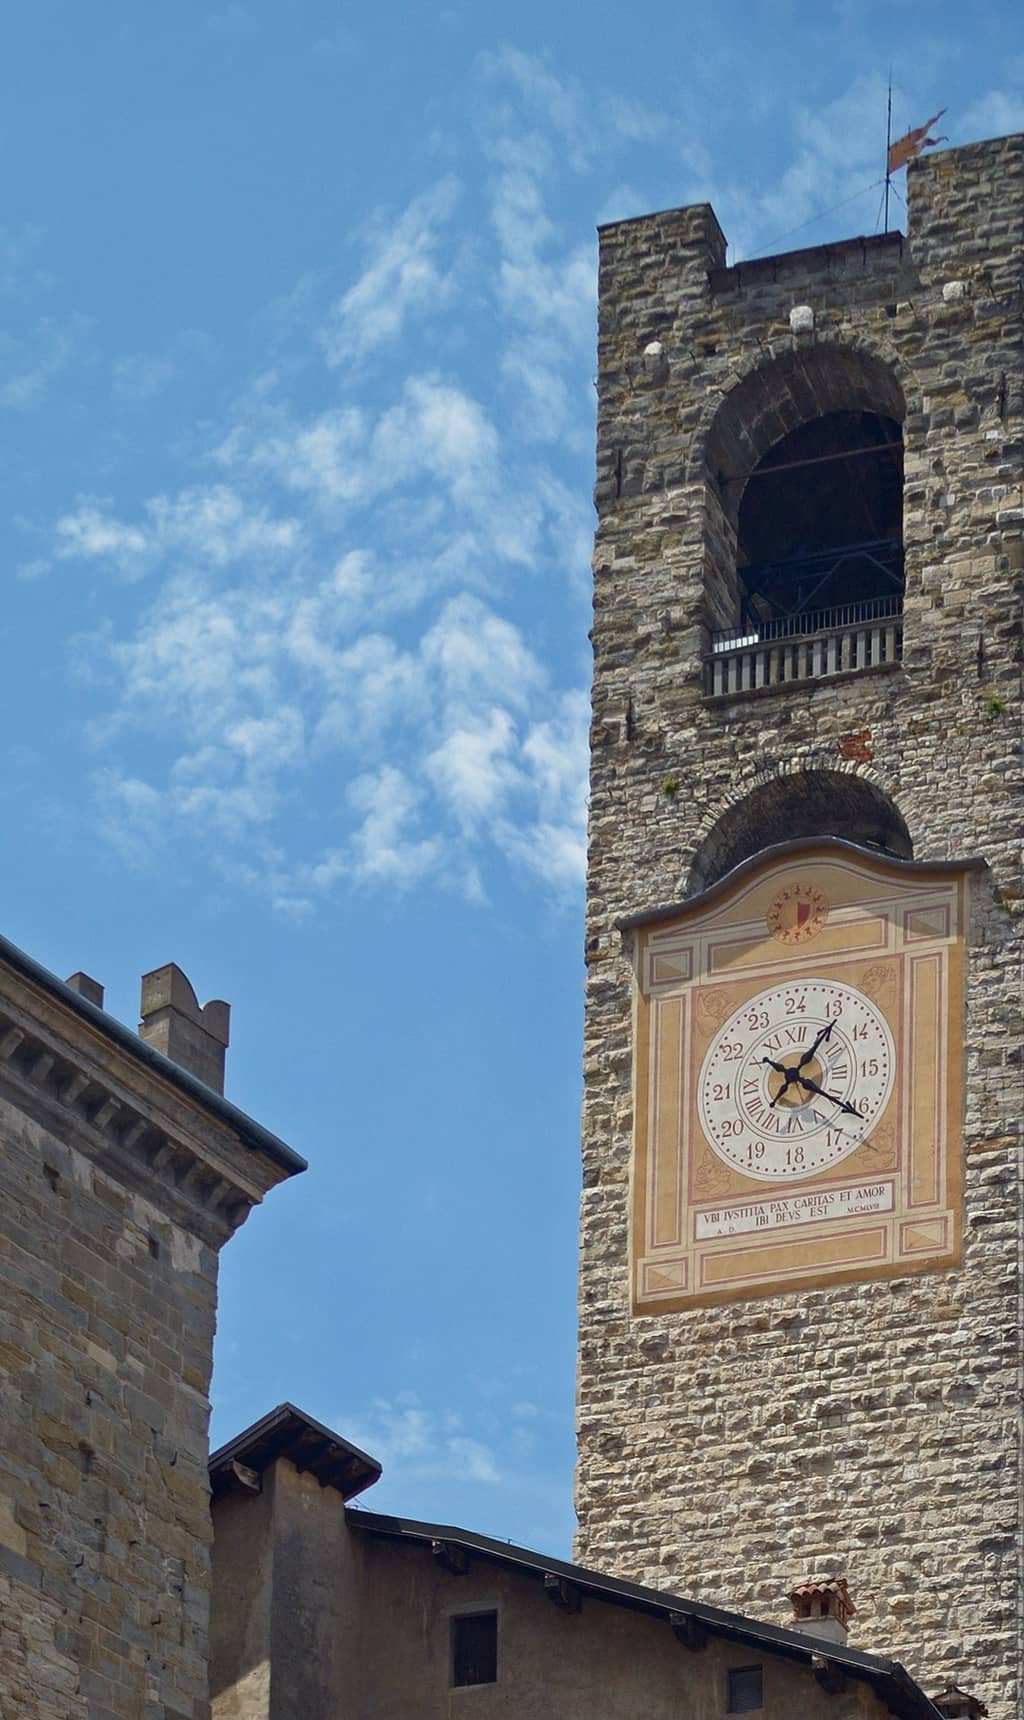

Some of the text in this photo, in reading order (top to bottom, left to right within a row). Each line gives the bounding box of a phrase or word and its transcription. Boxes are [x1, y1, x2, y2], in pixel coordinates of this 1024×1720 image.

[785, 995, 806, 1017] 24
[824, 1000, 843, 1018] 13
[748, 1012, 770, 1031] 23
[785, 1026, 807, 1045] XII
[852, 1022, 869, 1041] 14
[721, 1042, 743, 1062] 22
[762, 1034, 782, 1055] XI
[831, 1064, 847, 1080] III
[861, 1059, 878, 1078] 15
[713, 1084, 731, 1101] 21
[743, 1078, 759, 1095] IX
[745, 1097, 766, 1123] VIII
[721, 1118, 744, 1138] 20
[761, 1112, 780, 1133] VII
[787, 1117, 804, 1134] VI
[826, 1128, 844, 1147] 17
[747, 1141, 765, 1160] 19
[786, 1146, 804, 1165] 18
[770, 1201, 789, 1213] PAX
[794, 1193, 835, 1209] CARITAS
[840, 1191, 852, 1202] ET
[855, 1186, 885, 1199] AMOR
[755, 1204, 829, 1226] IBI DEVS EST
